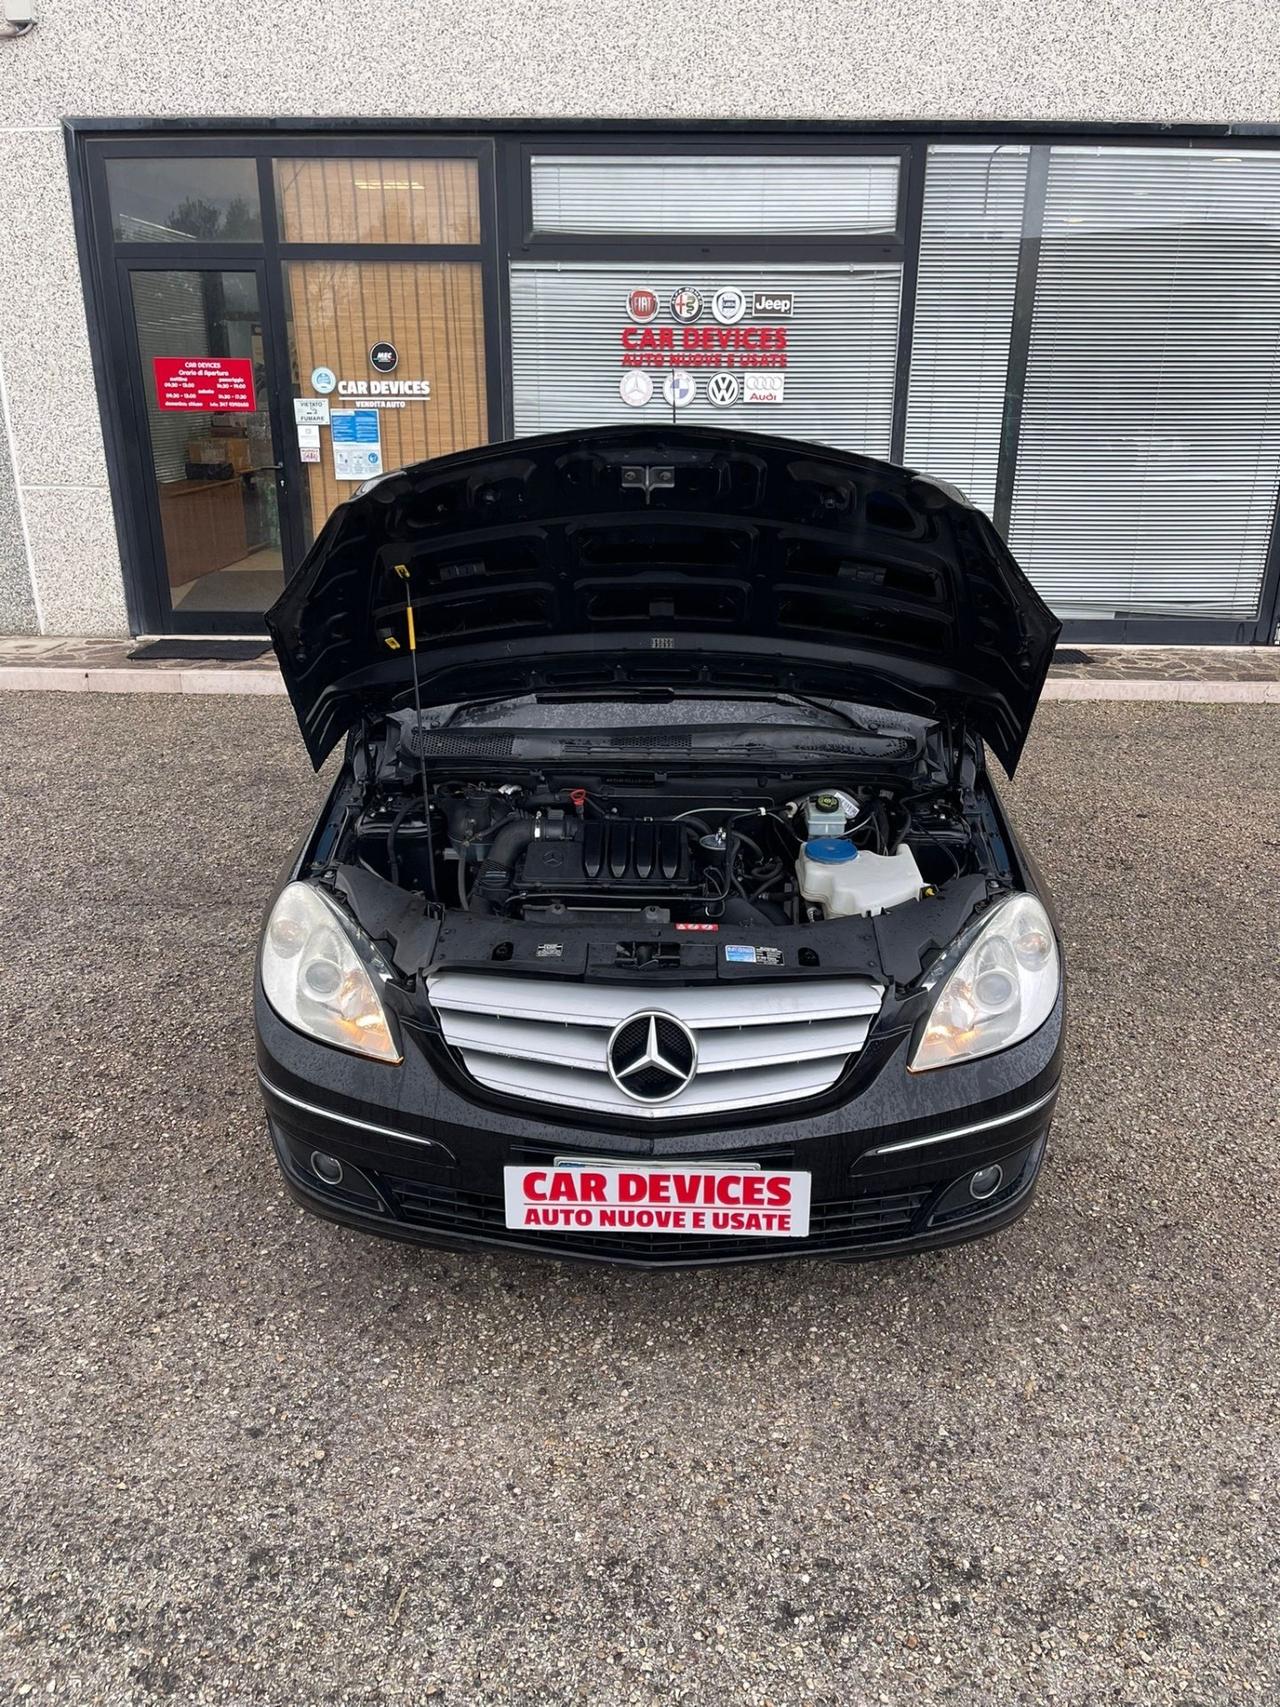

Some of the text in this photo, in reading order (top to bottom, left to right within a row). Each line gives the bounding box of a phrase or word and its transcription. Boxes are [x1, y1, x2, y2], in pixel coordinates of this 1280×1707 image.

[634, 296, 652, 312] FIAT
[755, 296, 790, 313] Jeep
[621, 327, 788, 350] CAR DEVICES
[621, 353, 788, 368] AUTO NUOVE E USATE
[337, 380, 431, 395] CAR DEVICES
[355, 401, 406, 409] VENDITA AUTO
[749, 392, 777, 402] Audi
[522, 1171, 792, 1206] CAR DEVICES
[524, 1208, 791, 1231] AUTO NUOVE E USATE
